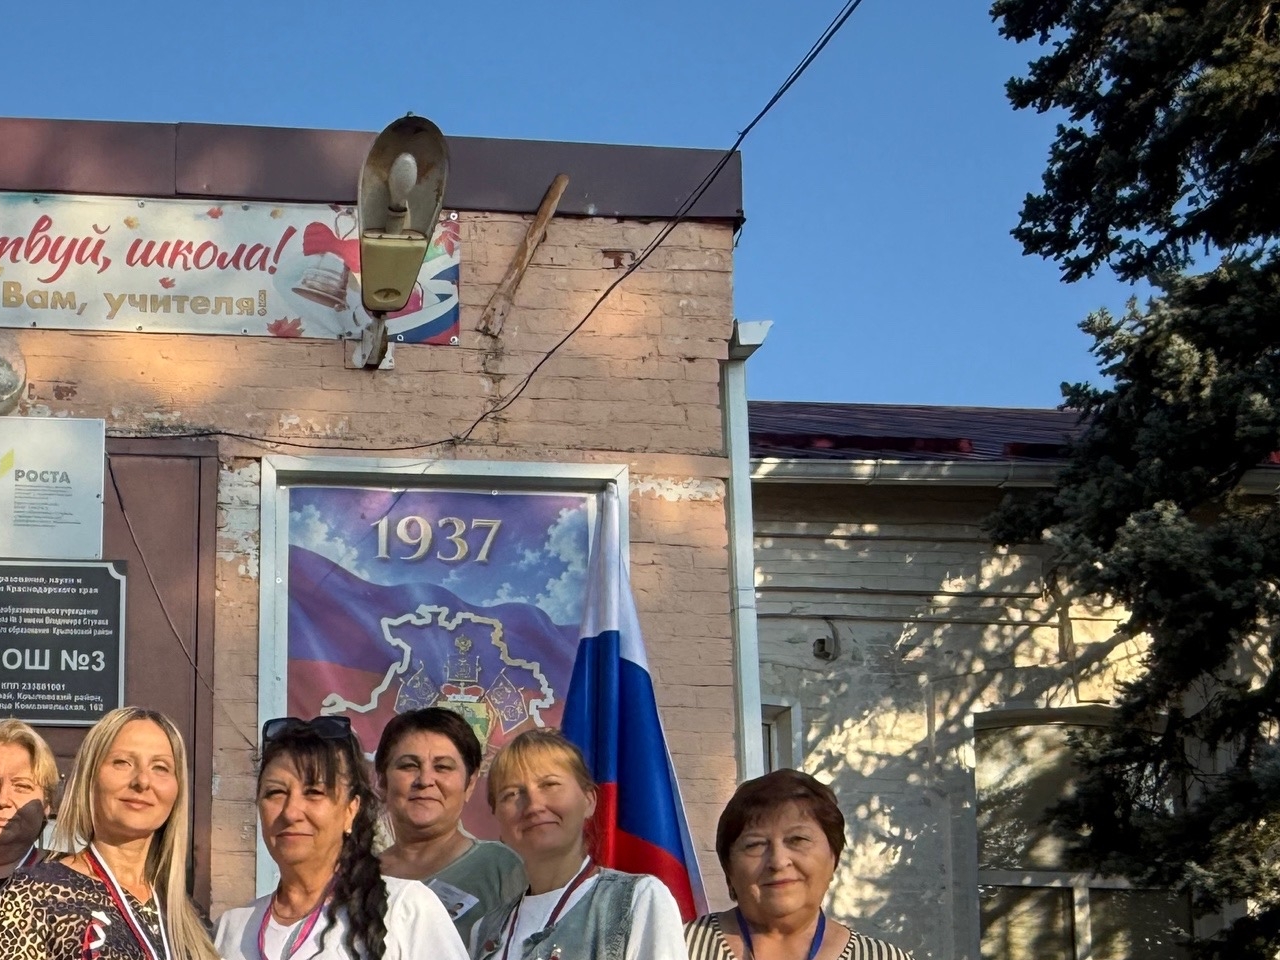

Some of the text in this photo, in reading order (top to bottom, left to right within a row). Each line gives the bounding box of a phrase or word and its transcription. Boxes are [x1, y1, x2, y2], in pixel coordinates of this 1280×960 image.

[126, 226, 297, 274] школа!
[2, 281, 87, 315] Вам,
[103, 289, 267, 319] учителя!
[14, 469, 71, 484] РОСТА
[370, 516, 502, 562] 1937
[6, 585, 76, 594] Краснодарского
[78, 587, 98, 595] края
[48, 577, 74, 585] науки
[60, 650, 106, 672] №3
[1, 682, 19, 690] КПП
